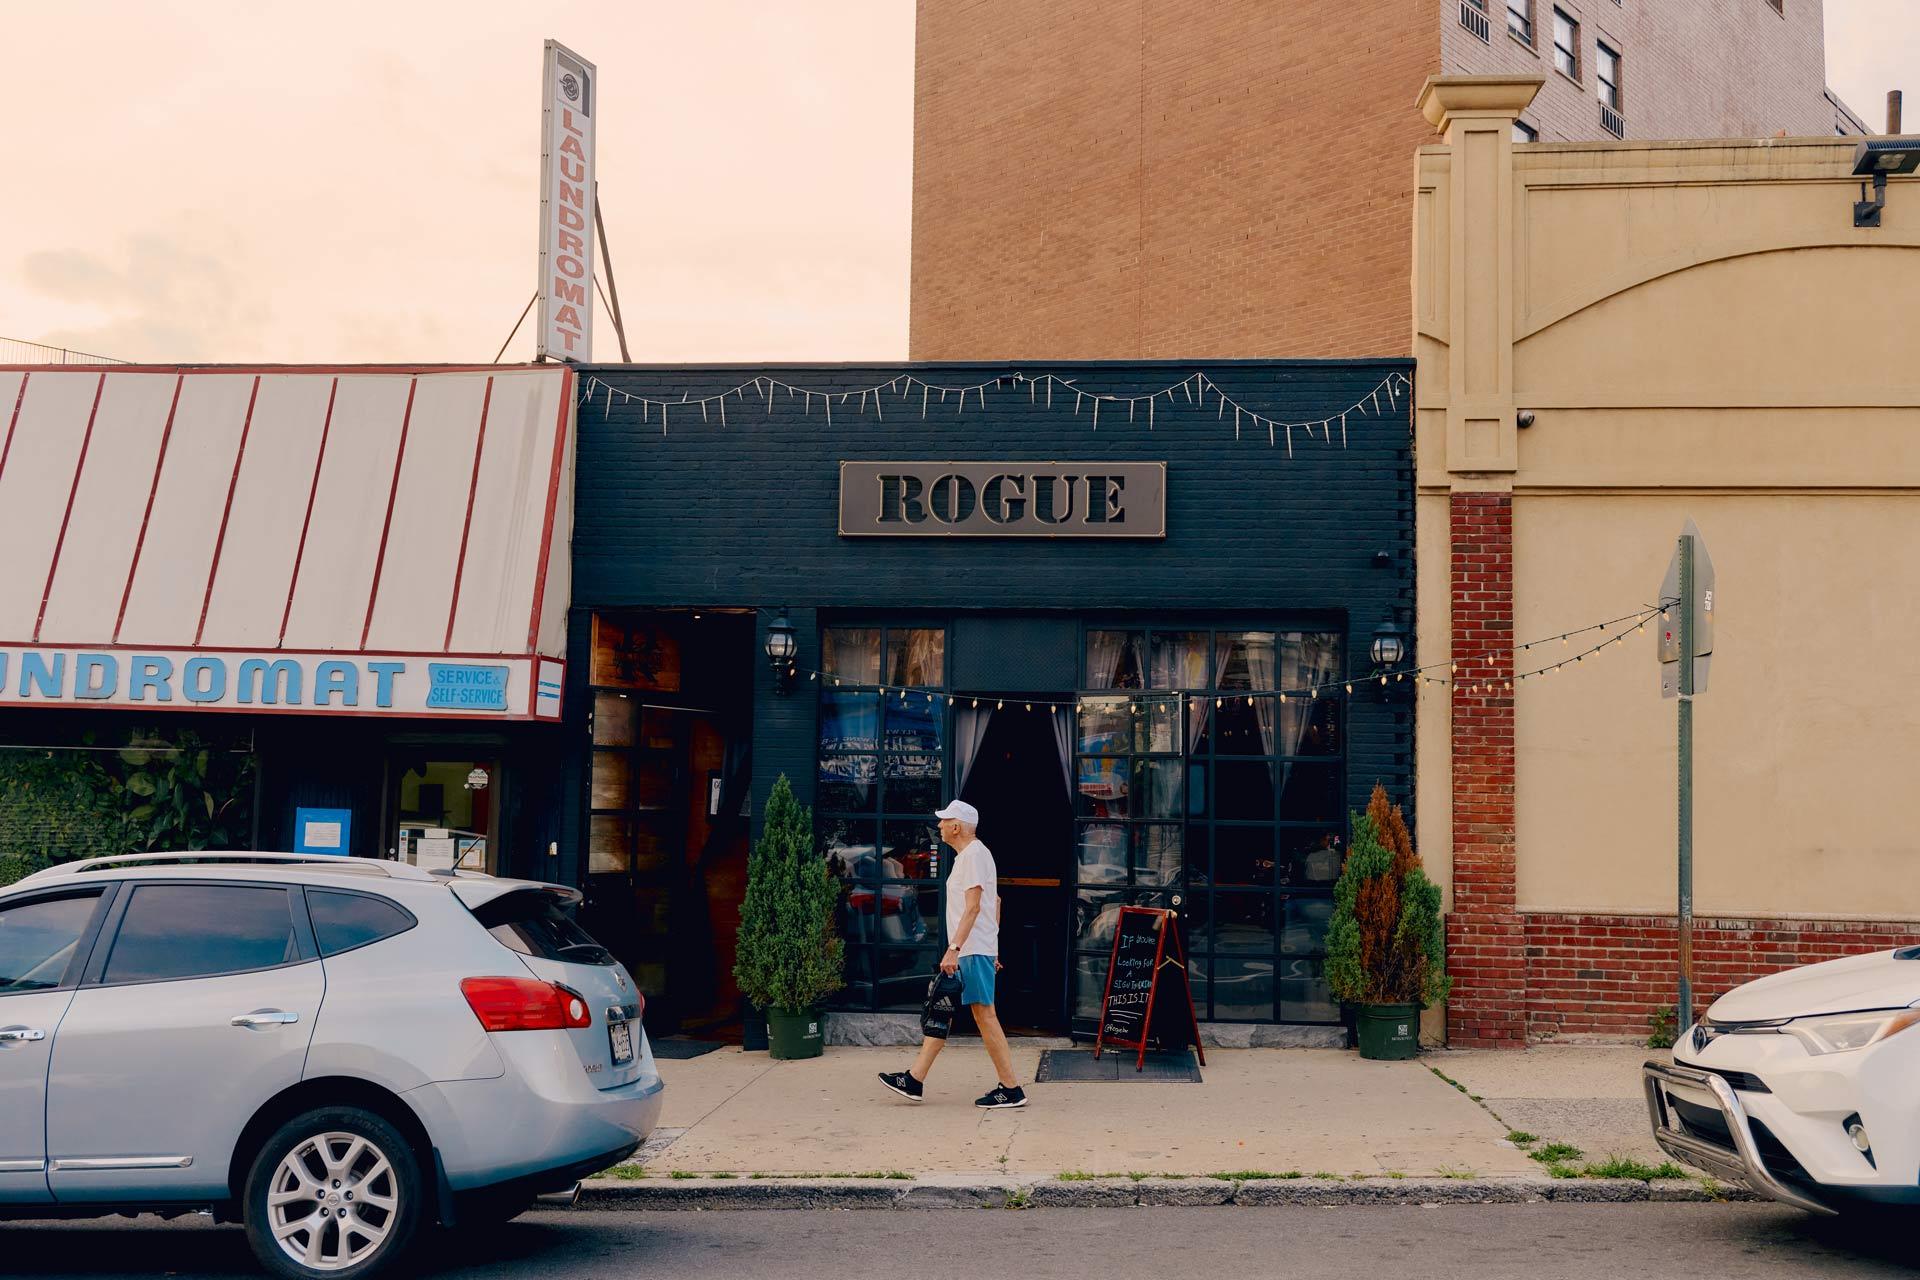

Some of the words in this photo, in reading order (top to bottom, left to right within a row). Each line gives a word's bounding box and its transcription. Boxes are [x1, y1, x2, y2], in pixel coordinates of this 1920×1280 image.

[554, 108, 586, 351] LAUNDROMAT
[876, 473, 1125, 525] ROGUE
[0, 652, 406, 707] NDROMAT
[437, 670, 492, 685] SERVICE
[432, 687, 503, 704] SELF-SERVICE
[1108, 993, 1127, 1007] THIS
